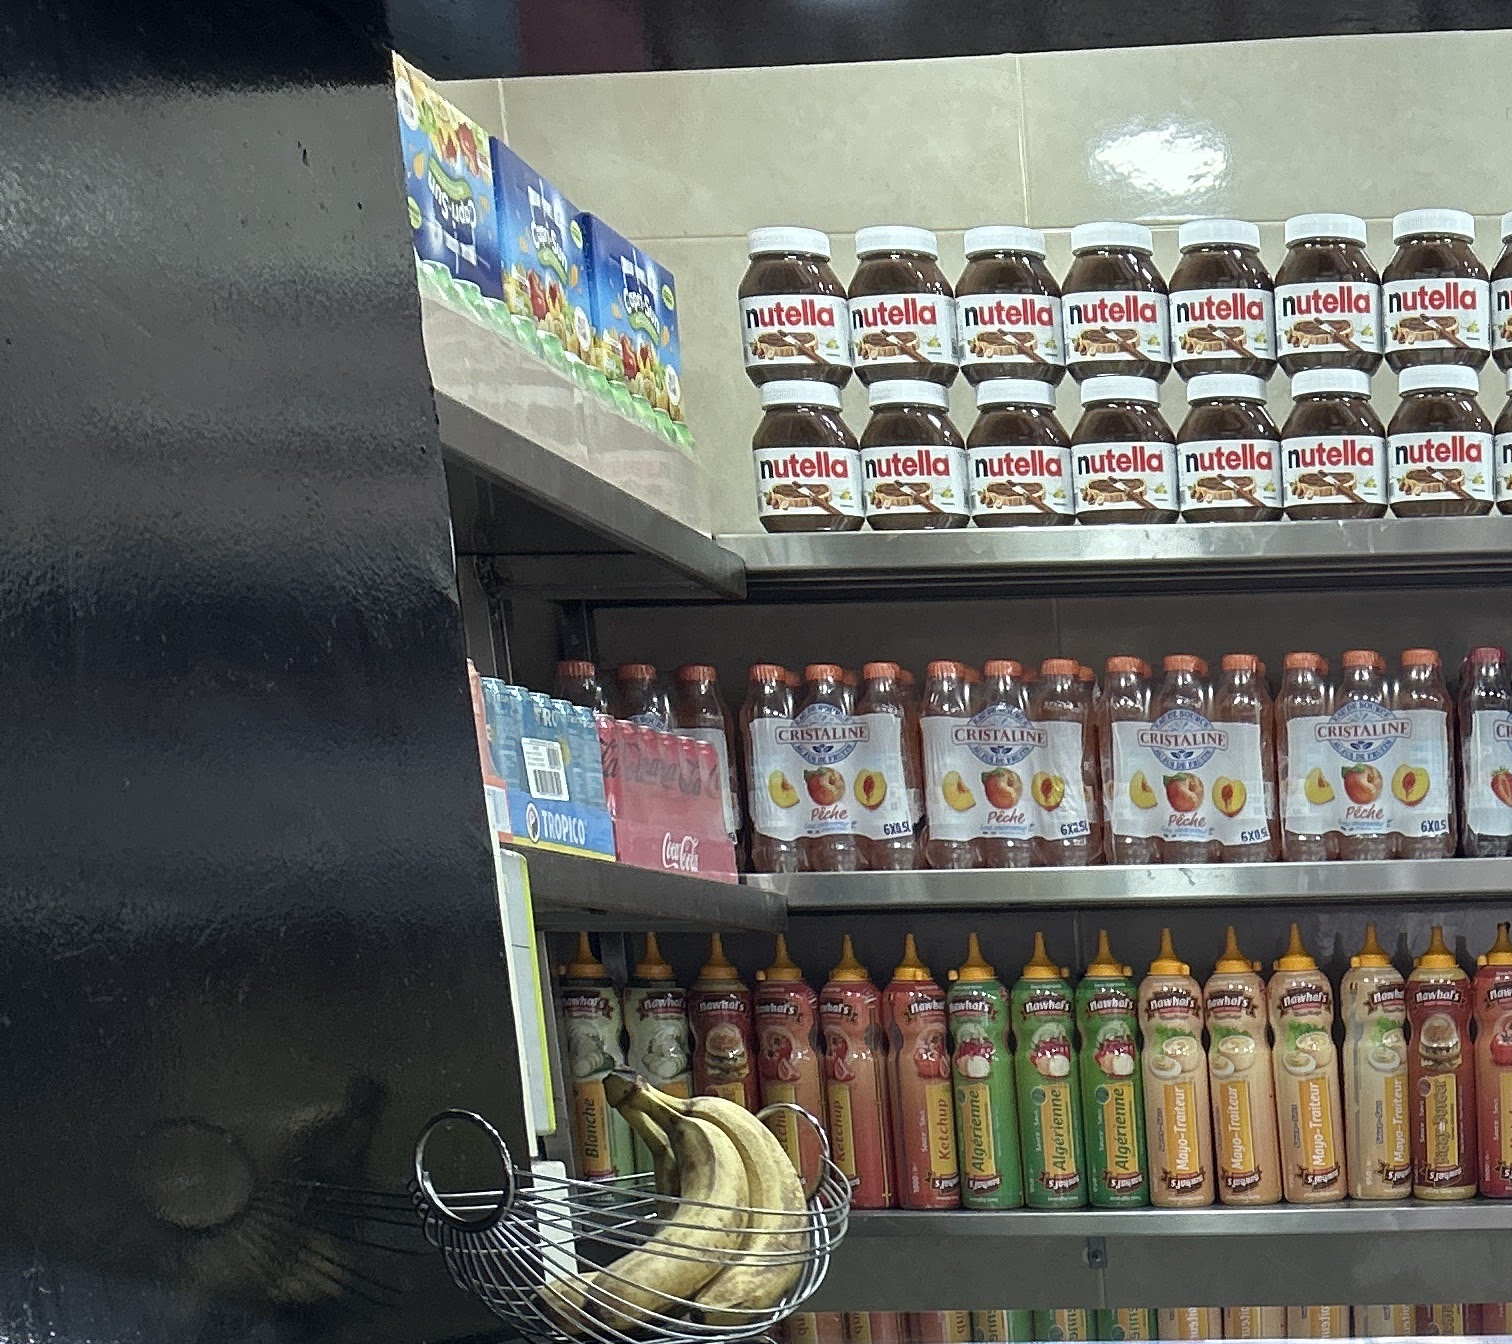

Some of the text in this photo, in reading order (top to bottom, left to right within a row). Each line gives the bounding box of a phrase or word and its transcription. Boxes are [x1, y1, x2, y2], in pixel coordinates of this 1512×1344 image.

[1069, 294, 1158, 325] nutella
[1176, 292, 1265, 324] nutella
[1282, 285, 1371, 317] nutella
[1389, 280, 1477, 312] nutella
[746, 299, 834, 329] nutella
[852, 297, 938, 330] nutella
[963, 299, 1054, 327] nutella
[760, 451, 849, 479] nutella
[864, 449, 951, 479] nutella
[974, 450, 1063, 478] nutella
[1077, 446, 1164, 475] nutella
[1185, 443, 1273, 474] nutella
[1288, 439, 1374, 470] nutella
[1395, 434, 1482, 466] nutella
[778, 725, 868, 742] CRISTALINE
[954, 728, 1046, 745] CRISTALINE
[1140, 732, 1226, 747] CRISTALINE
[1317, 721, 1409, 739] CRISTALINE
[811, 804, 849, 821] Pêche
[987, 807, 1026, 824] Pêche
[1167, 811, 1207, 828] Pêche
[1345, 804, 1385, 819] Pêche
[541, 810, 587, 846] TROPICO
[585, 1096, 598, 1160] Blanche
[938, 1098, 950, 1161] Ketchup
[971, 1089, 986, 1173] Algérienne
[1051, 1089, 1067, 1172] Algérienne
[1113, 1087, 1129, 1171] Algérienne
[1175, 1086, 1189, 1171] Mayo-Traiteur
[1230, 1085, 1244, 1170] Mayo-Traiteur
[1311, 1082, 1325, 1167] Mayo-Traiteur
